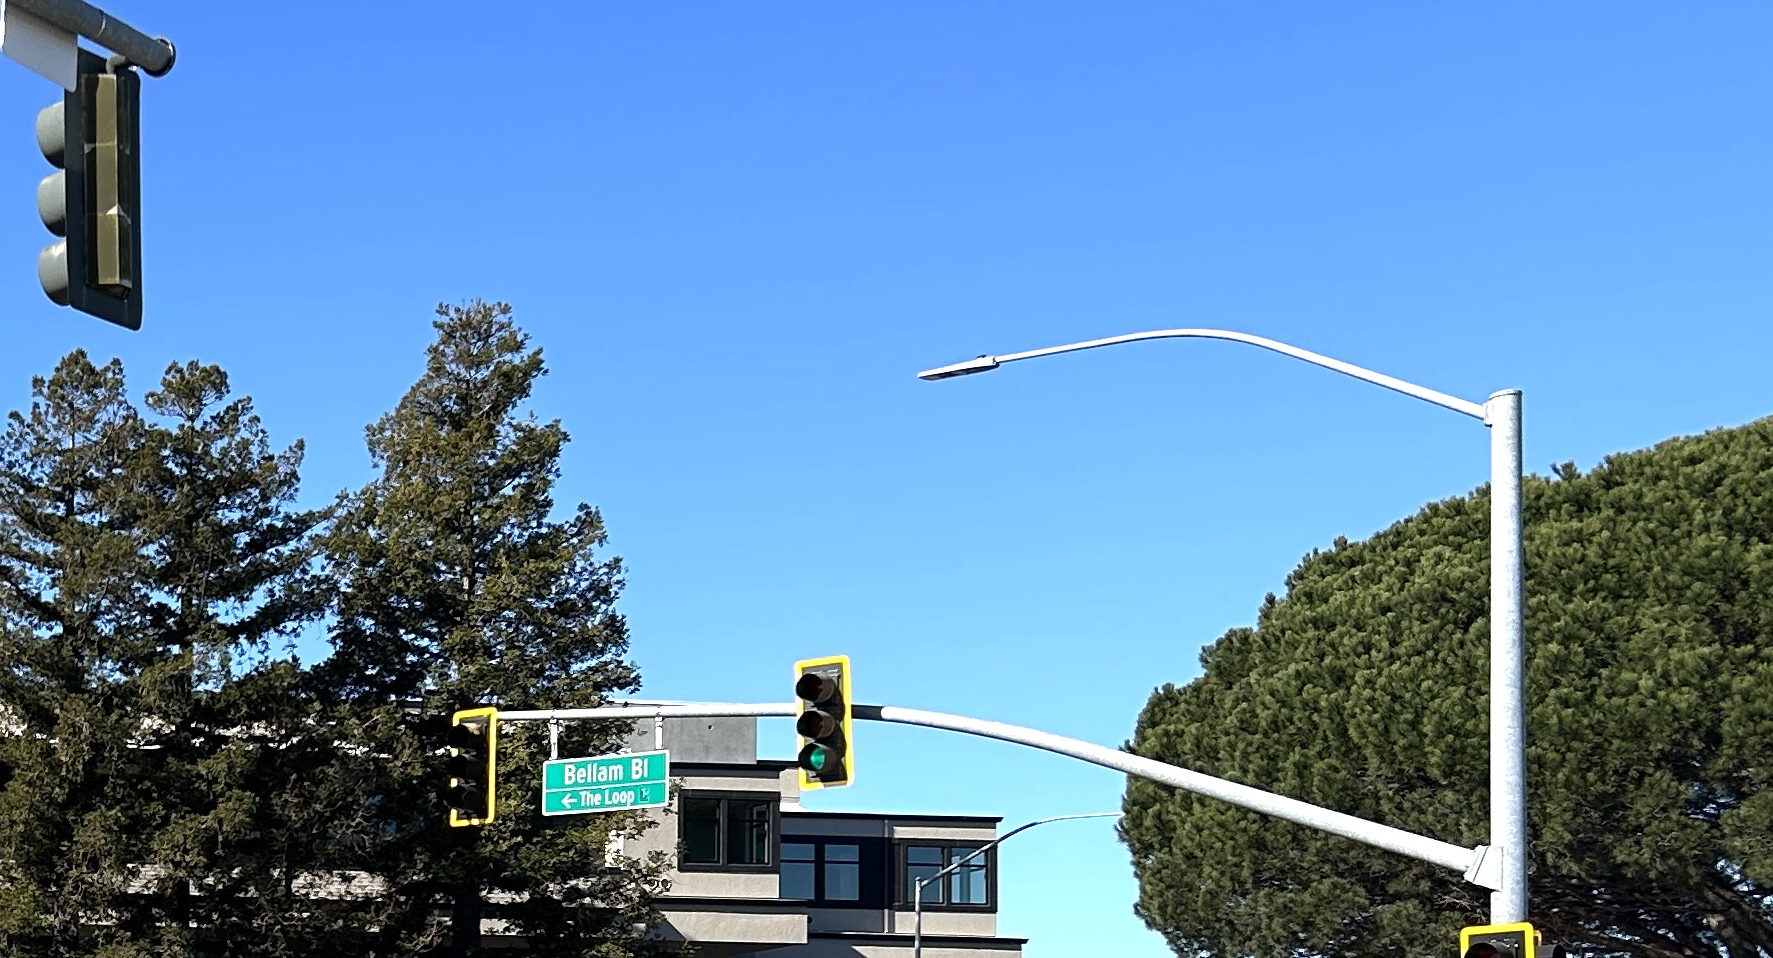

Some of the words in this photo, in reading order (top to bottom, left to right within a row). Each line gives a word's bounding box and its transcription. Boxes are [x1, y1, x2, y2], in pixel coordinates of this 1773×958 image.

[564, 763, 623, 785] Bellam
[631, 758, 648, 780] Bl
[579, 790, 602, 806] The
[605, 789, 635, 807] Loop
